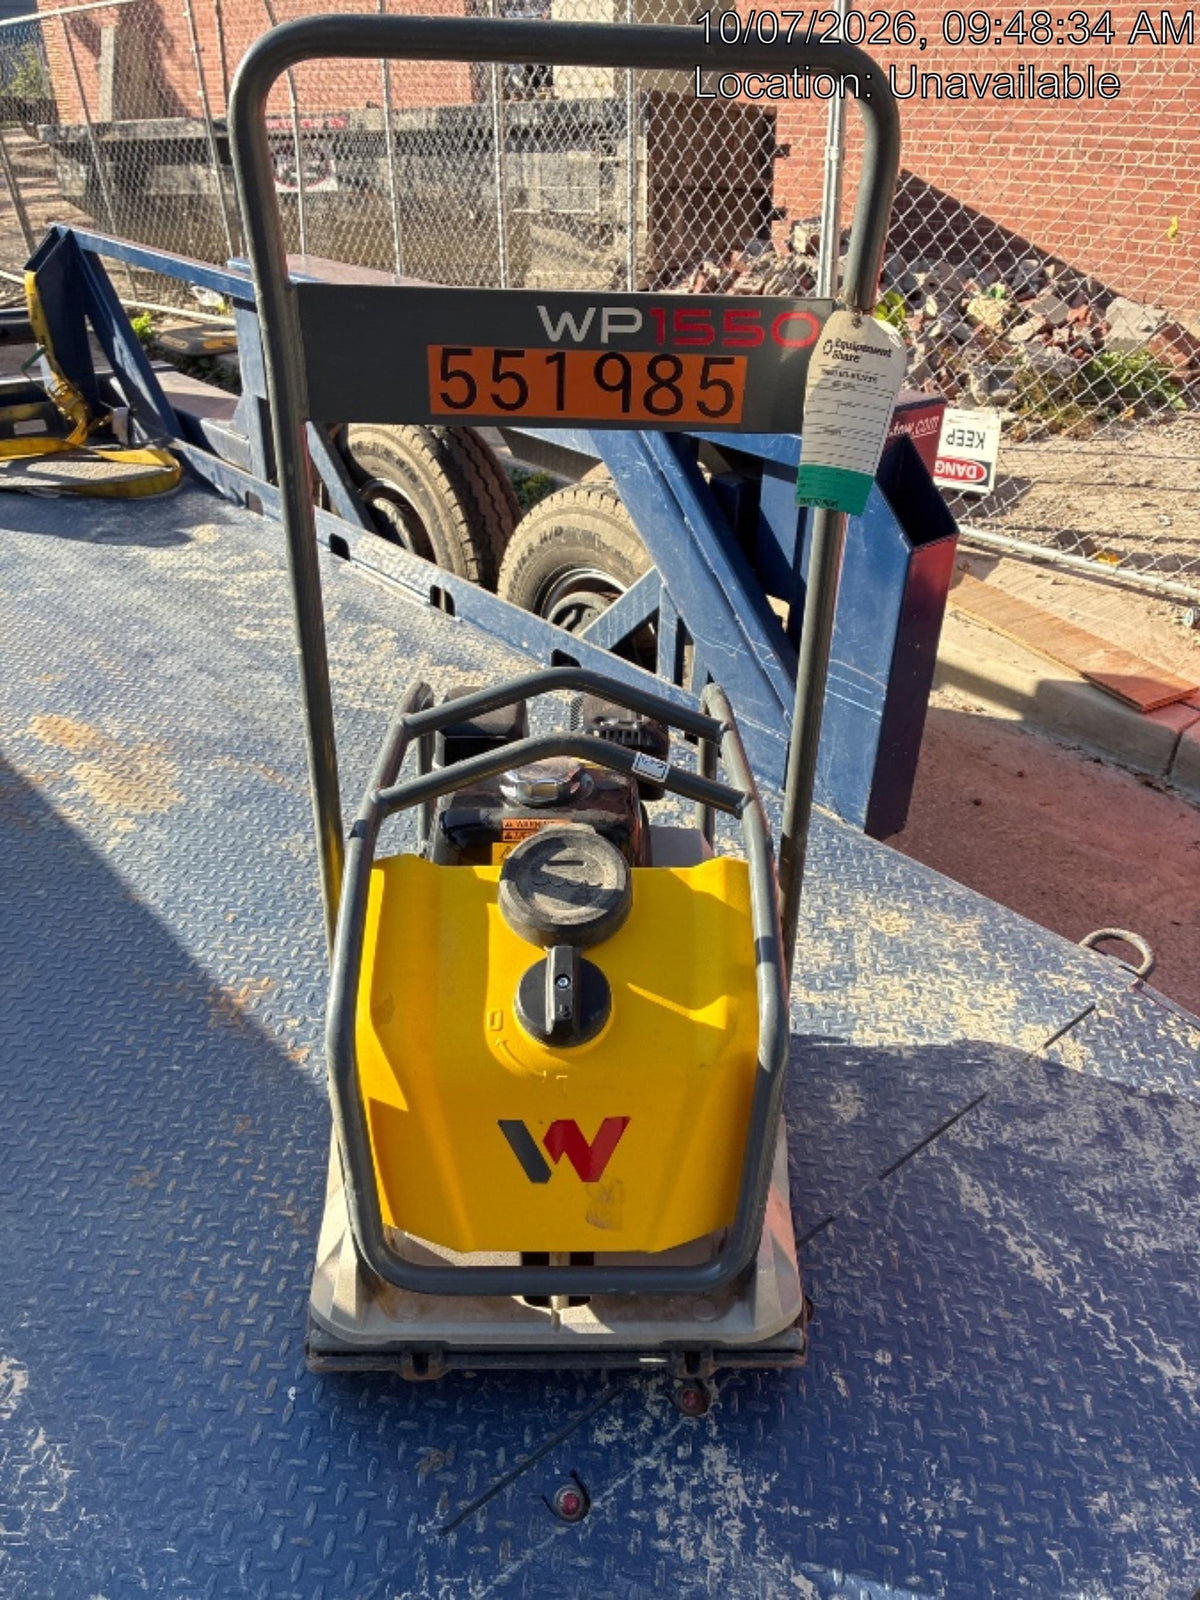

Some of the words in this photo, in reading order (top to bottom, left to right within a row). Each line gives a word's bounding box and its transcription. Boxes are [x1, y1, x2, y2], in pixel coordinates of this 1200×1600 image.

[537, 305, 820, 349] WP1550
[439, 347, 736, 418] 551985
[945, 428, 986, 450] KEEP
[935, 460, 977, 479] DANG
